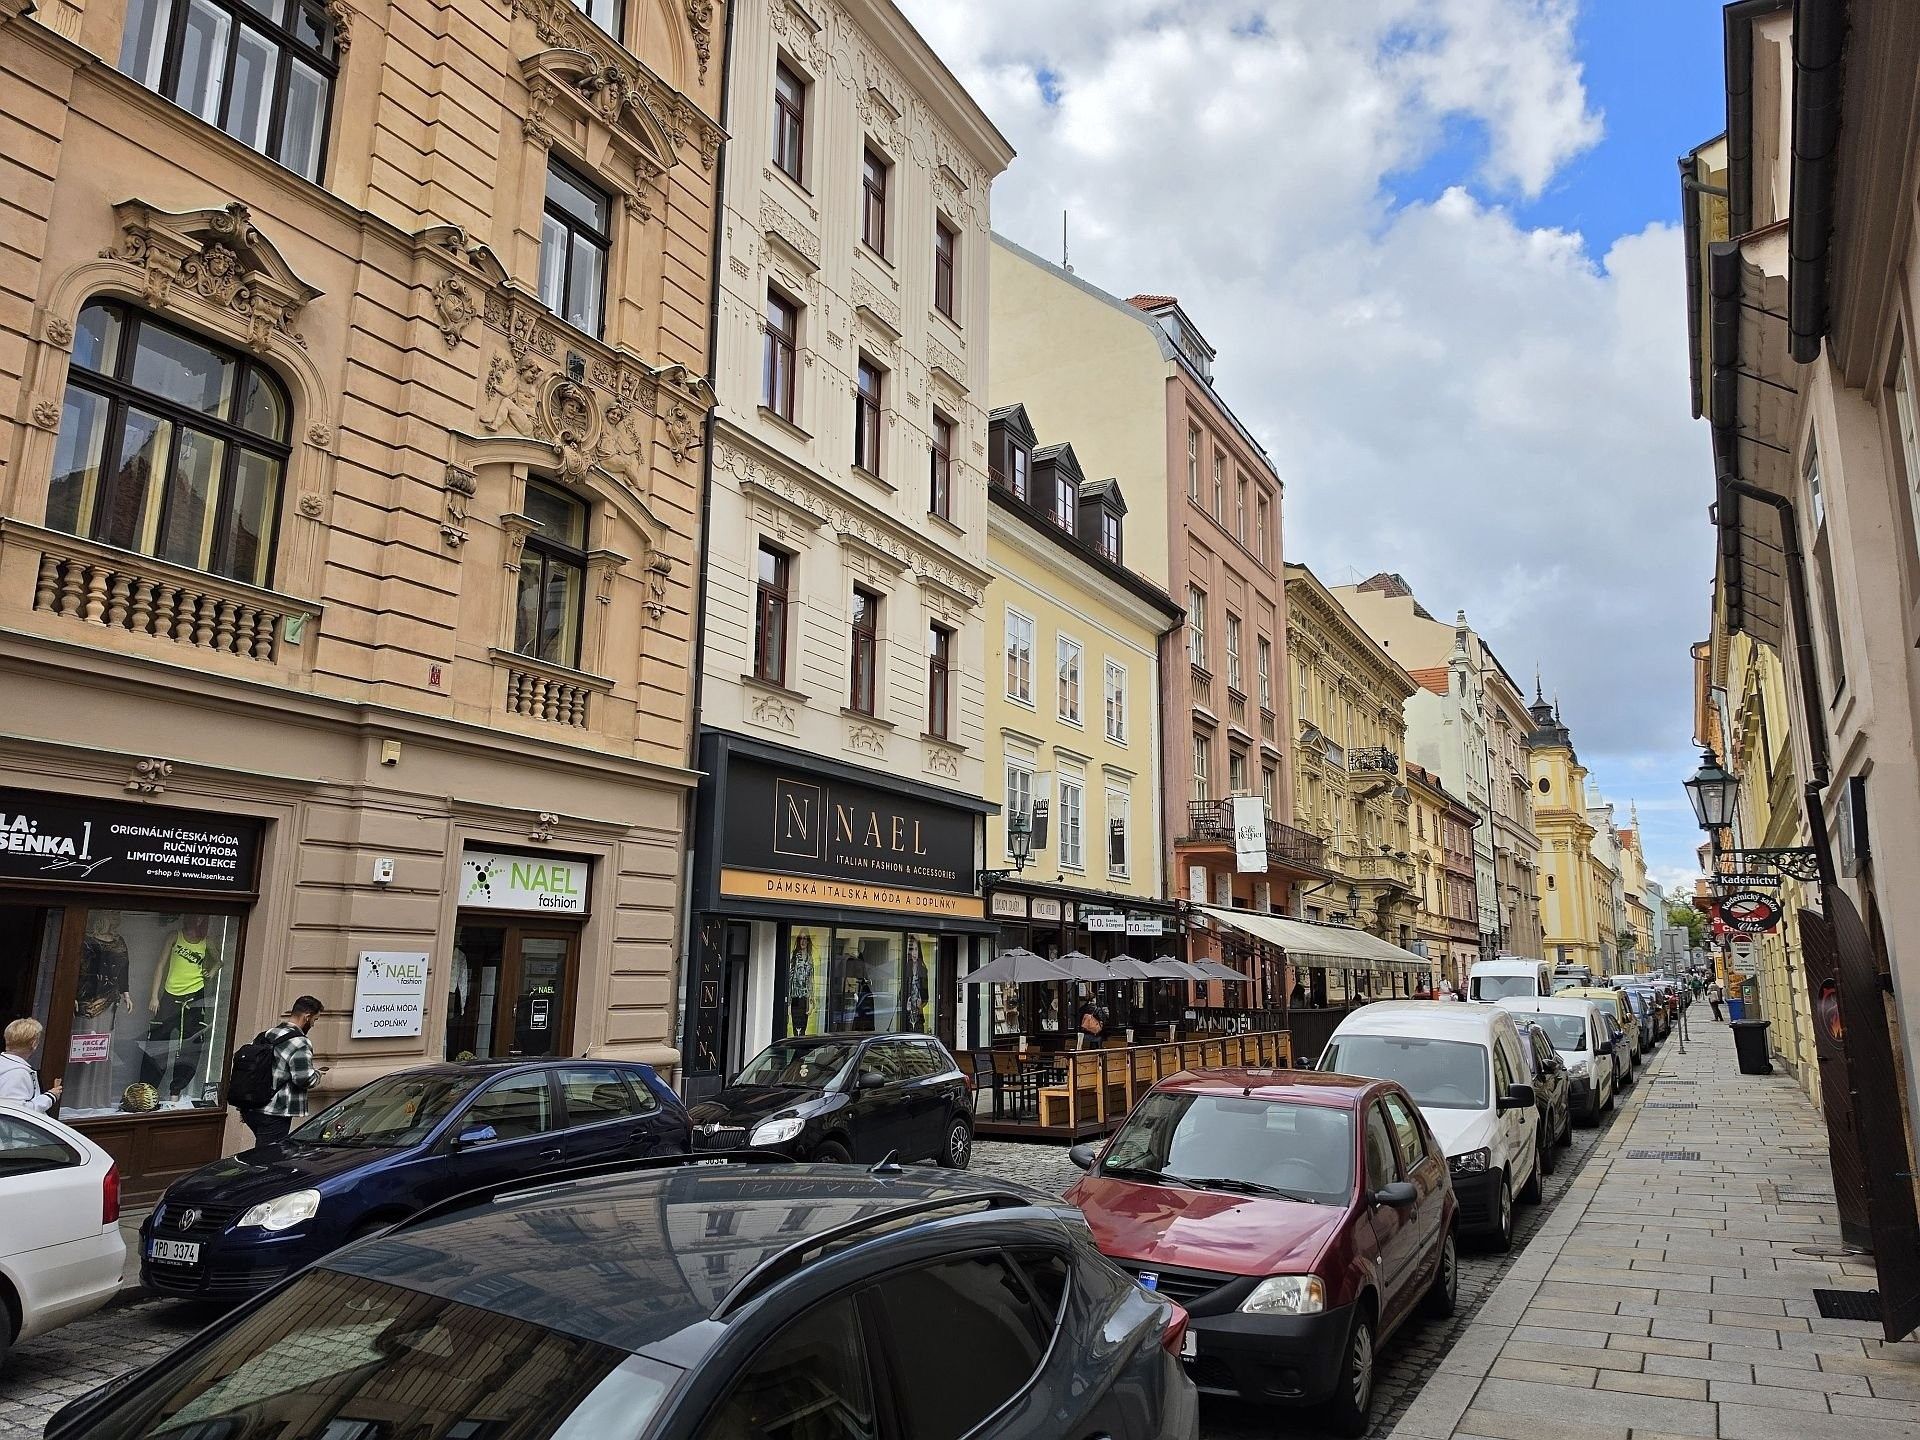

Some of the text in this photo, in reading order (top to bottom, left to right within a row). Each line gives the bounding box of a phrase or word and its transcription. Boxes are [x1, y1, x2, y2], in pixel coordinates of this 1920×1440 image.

[110, 824, 239, 846] ORIGINÁLNÍ ČESKÁ MÓDA
[835, 804, 927, 855] NAEL
[163, 841, 238, 857] RUČNÍ VÝROBA
[126, 851, 237, 869] LIMITOVANÉ KOLEKCE
[836, 854, 956, 880] ITALIAN FASHION & ACCESSORIES
[146, 868, 235, 882] e-shop www.lasenka.cz
[510, 862, 578, 895] NAEL
[1721, 875, 1777, 885] Kadeřnictví
[767, 877, 956, 909] DÁMSKÁ ITALSKÁ MÓDA A DOPLŇKY
[538, 893, 577, 909] fashion
[1090, 918, 1104, 927] T.O.
[1128, 924, 1141, 932] T.O.
[1737, 921, 1764, 932] Chic
[386, 964, 422, 978] NAEL
[400, 977, 422, 985] fashion
[538, 986, 555, 994] NAEL
[365, 1004, 395, 1012] DÁMSKÁ
[373, 1018, 408, 1028] DOPLŇKY
[154, 1240, 195, 1260] 1PD 3374
